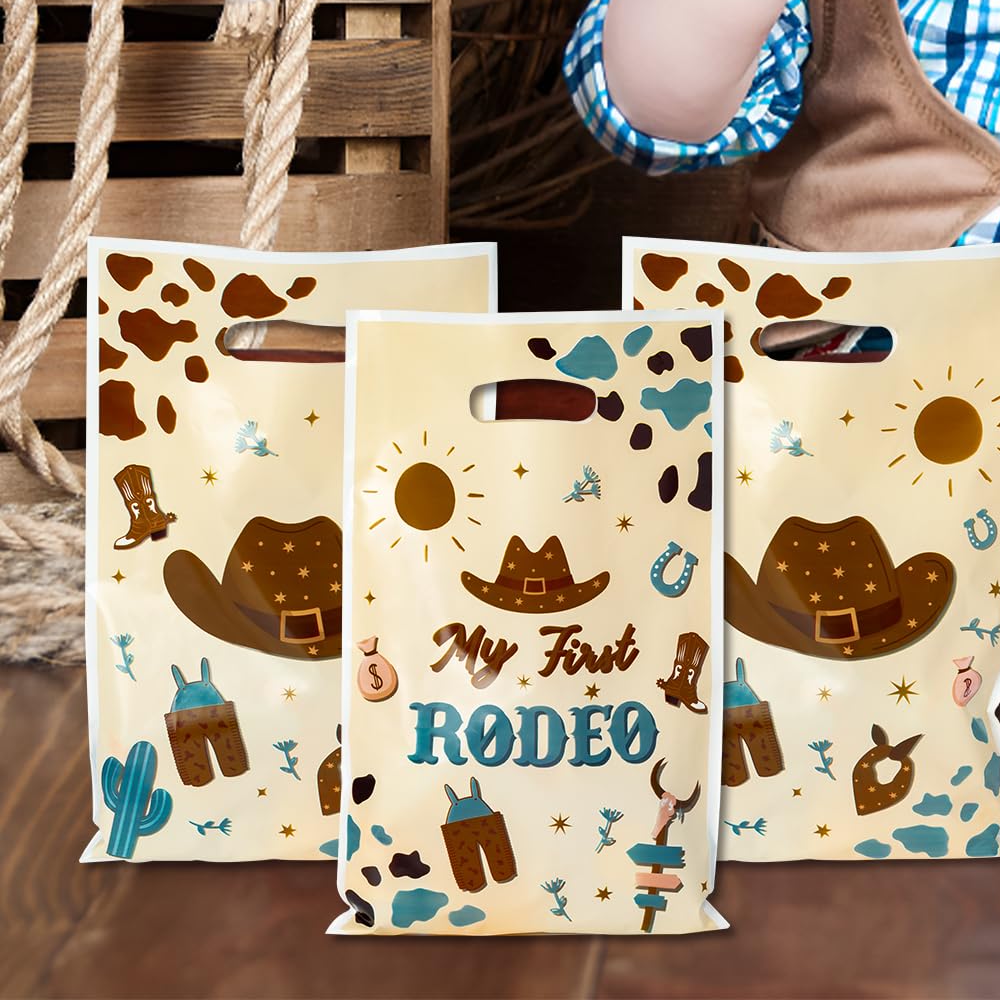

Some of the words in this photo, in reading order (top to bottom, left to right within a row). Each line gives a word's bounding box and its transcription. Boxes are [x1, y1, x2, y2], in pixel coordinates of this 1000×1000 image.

[429, 622, 519, 689] My
[537, 623, 640, 678] First
[406, 701, 660, 768] RODEO
